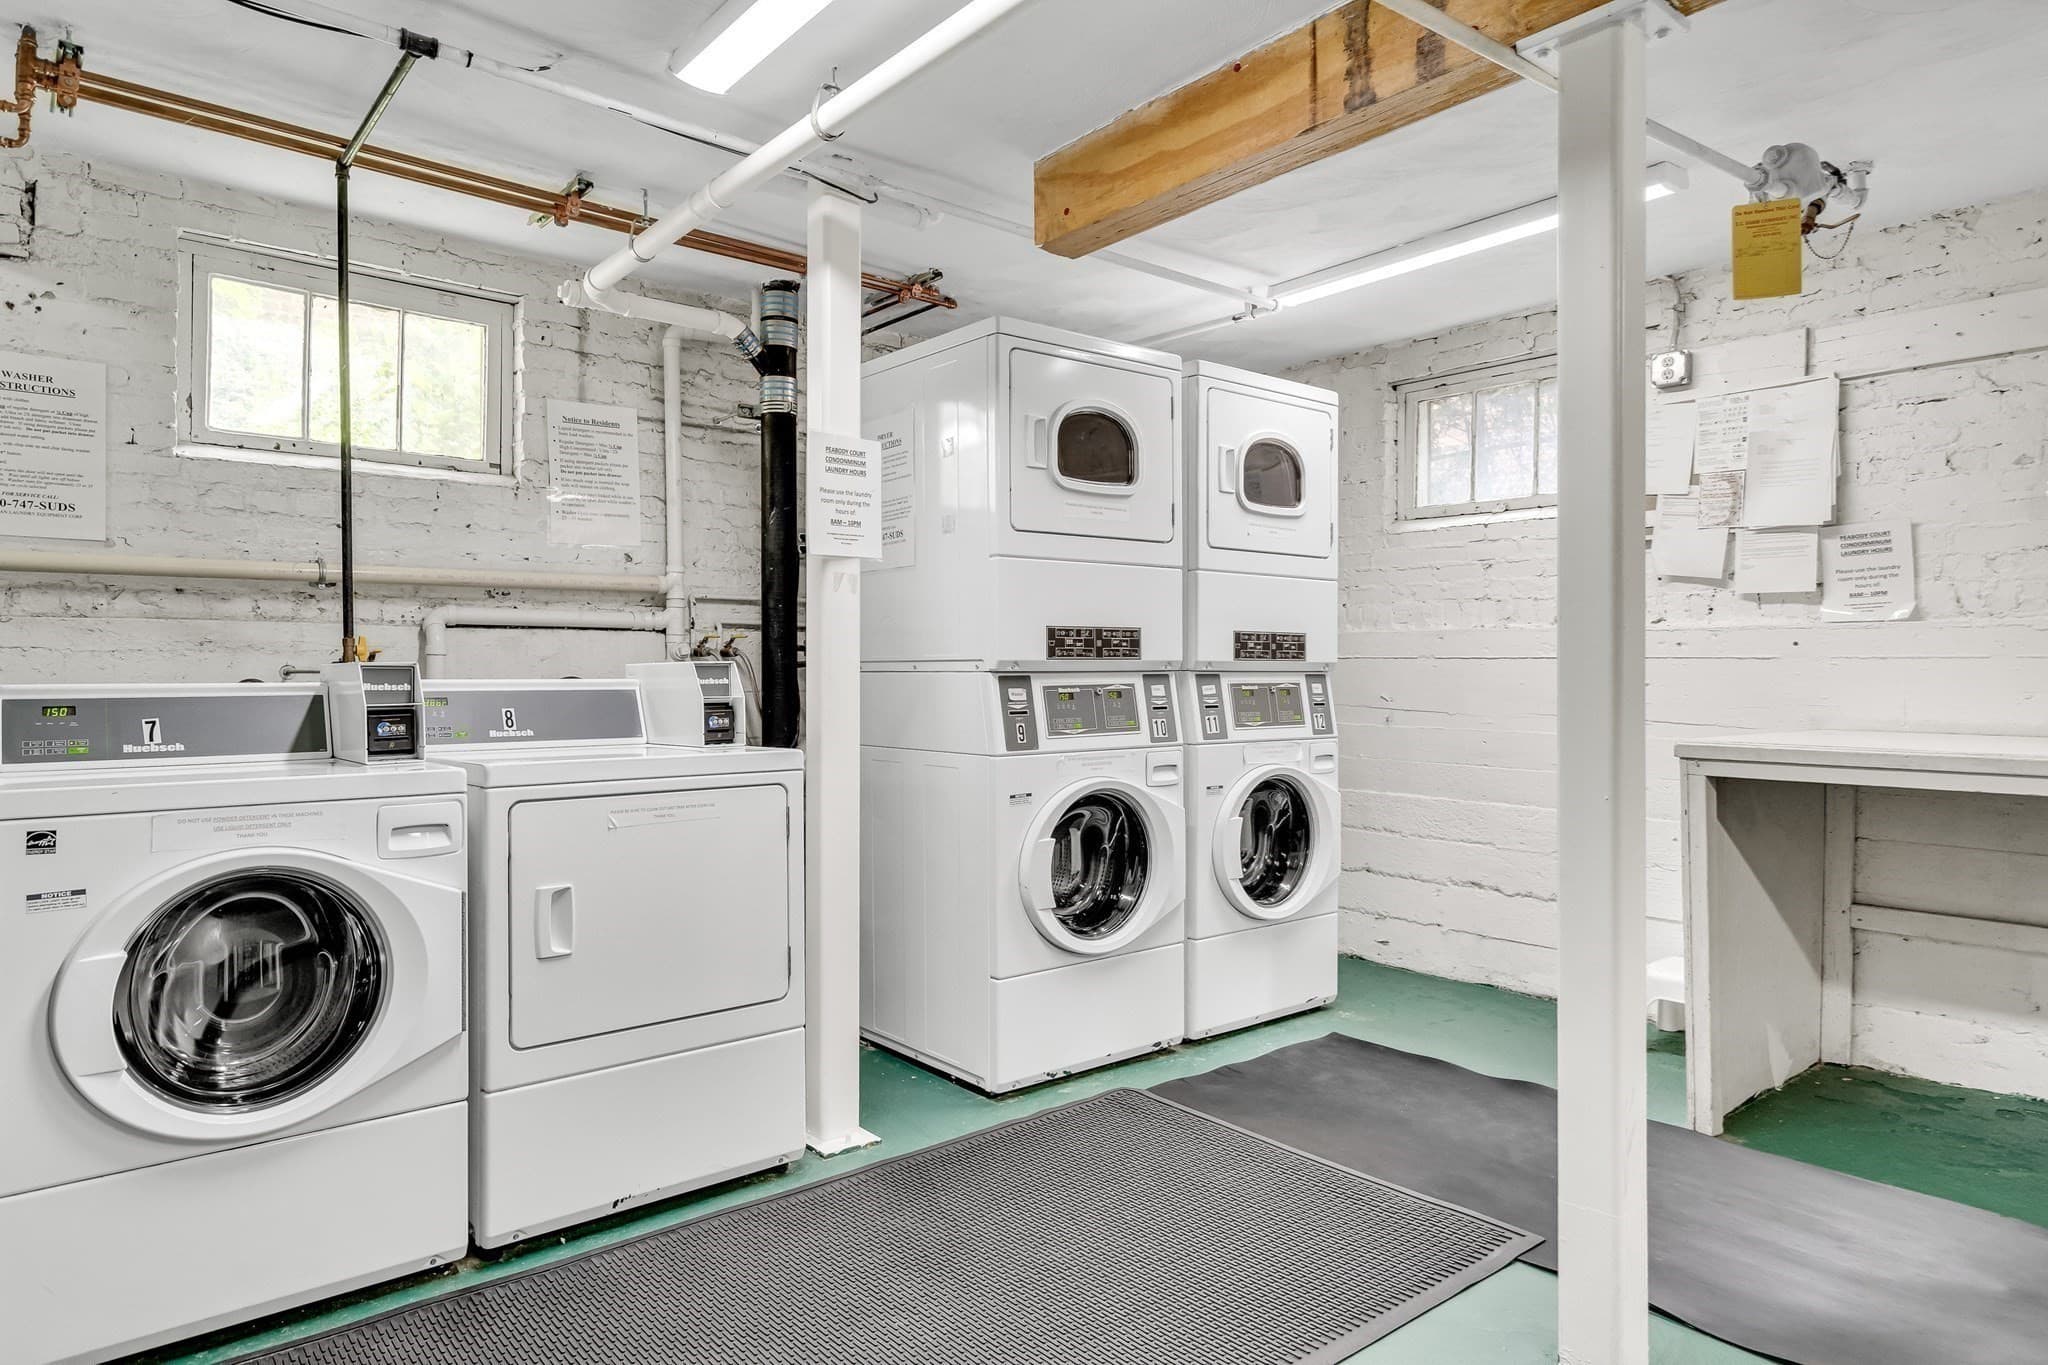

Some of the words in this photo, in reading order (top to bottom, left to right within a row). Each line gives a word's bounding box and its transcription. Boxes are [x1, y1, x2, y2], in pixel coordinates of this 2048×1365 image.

[2, 370, 54, 384] WASHER
[562, 415, 582, 423] Notice
[591, 418, 620, 428] Residents
[825, 466, 848, 474] LAUNDRY
[363, 682, 411, 691] Huebsch
[46, 707, 68, 717] 150
[505, 710, 514, 728] 8
[1206, 716, 1219, 732] 11
[1314, 714, 1326, 729] 12
[144, 720, 157, 743] 7
[489, 728, 535, 737] Huebsch
[1018, 724, 1026, 742] 9
[1153, 719, 1167, 737] 10
[123, 743, 185, 753] Huebsch
[41, 890, 72, 899] NOTICE
